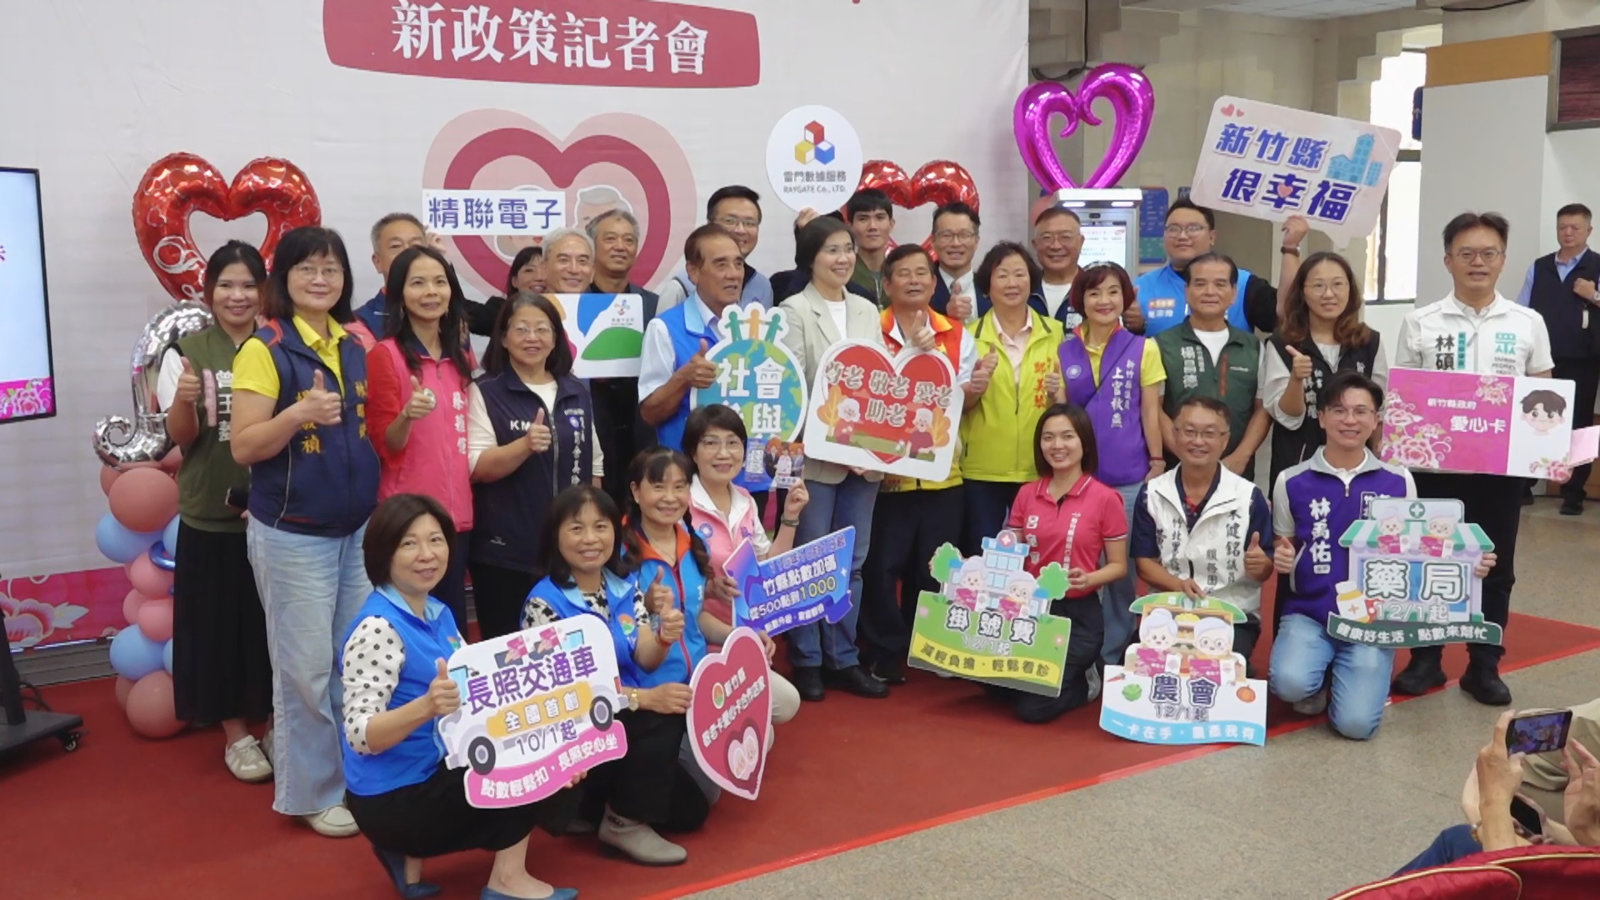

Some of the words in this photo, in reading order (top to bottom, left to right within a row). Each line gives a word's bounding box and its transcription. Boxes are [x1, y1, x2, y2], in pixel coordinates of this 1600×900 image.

[391, 1, 709, 75] 新政策記者會
[1215, 123, 1328, 169] 新竹縣
[428, 197, 562, 230] 精聯電子
[1221, 168, 1357, 221] 很幸福
[717, 357, 786, 399] 社會
[1450, 415, 1506, 434] 愛心卡
[1364, 560, 1465, 602] 藥局
[945, 605, 1036, 645] 掛號費
[1376, 598, 1450, 623] 12/1起
[466, 645, 598, 715] 長照交通車
[1152, 673, 1218, 707] 農會
[503, 688, 580, 733] 全國首創
[516, 719, 578, 755] 10/1起
